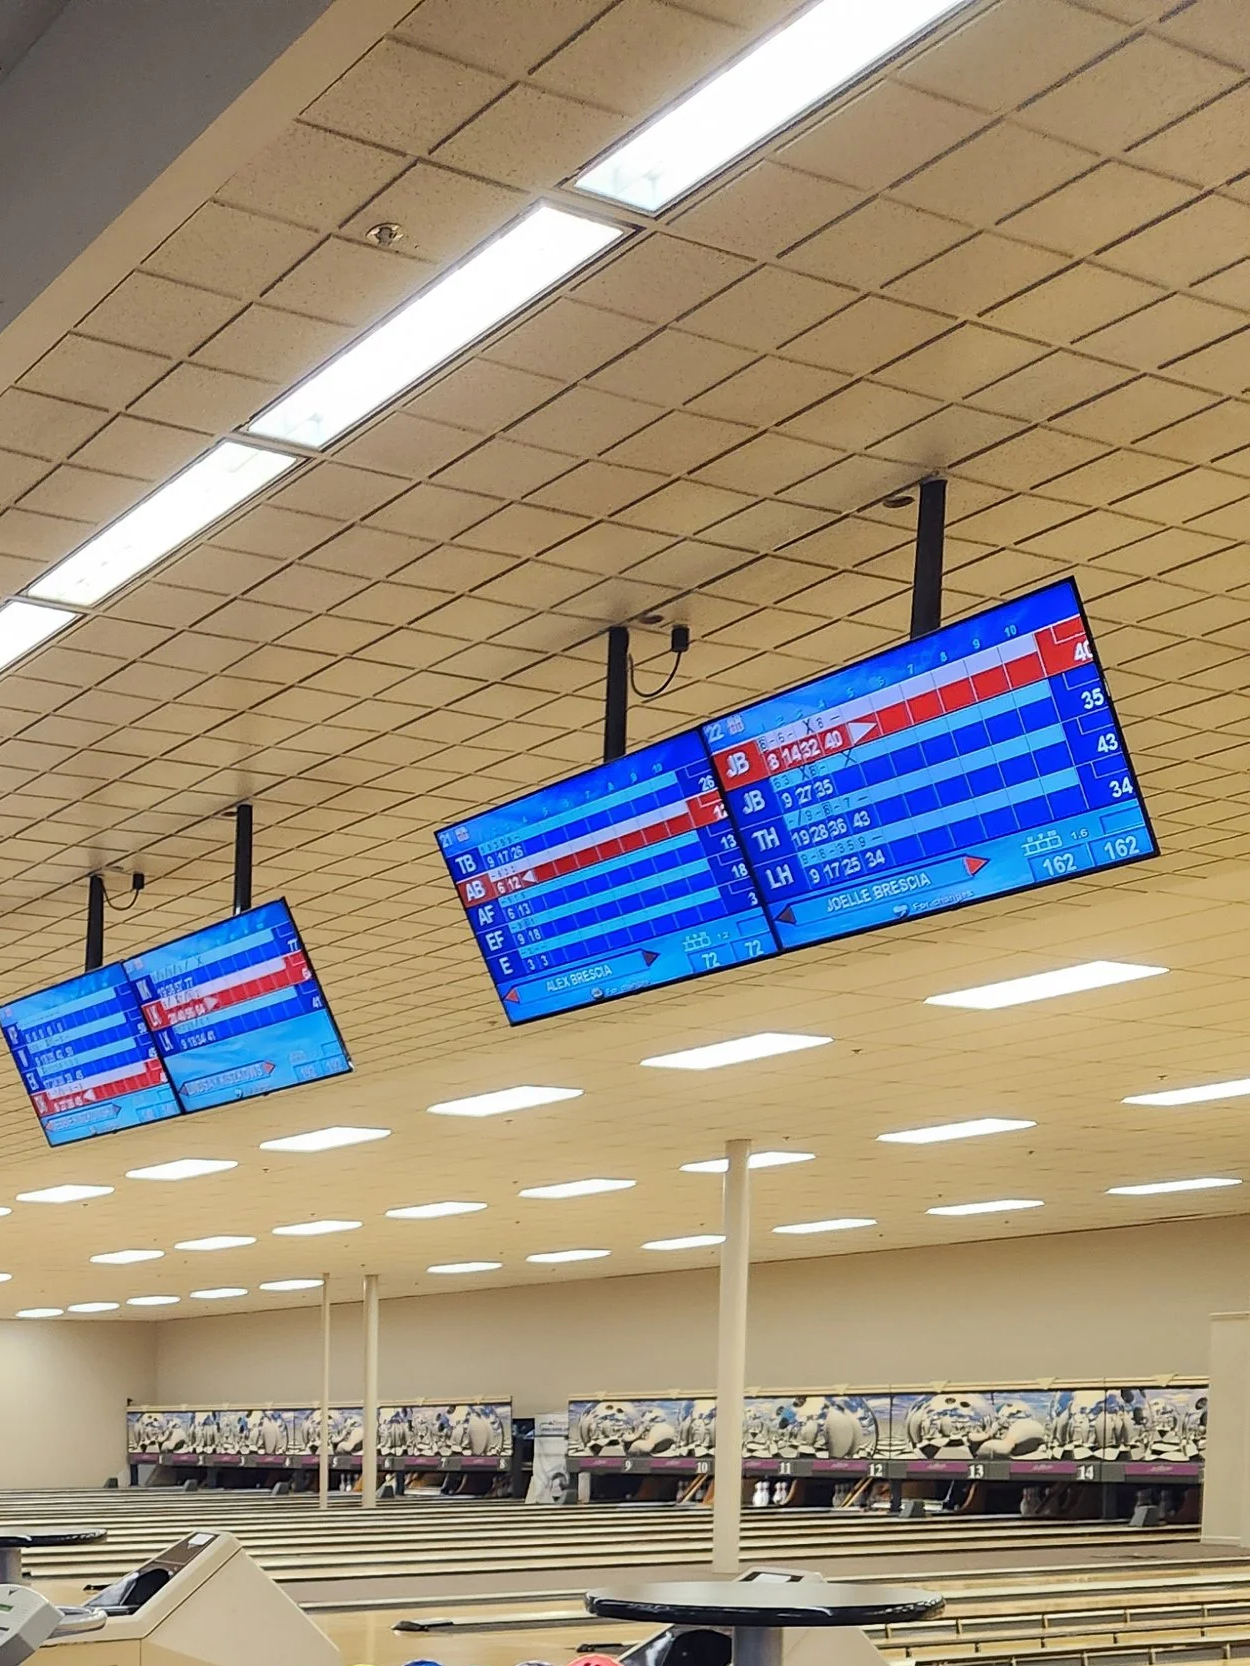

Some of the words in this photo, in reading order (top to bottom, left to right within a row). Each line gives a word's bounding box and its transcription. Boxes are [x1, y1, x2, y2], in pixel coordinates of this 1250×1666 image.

[940, 652, 948, 663] 8
[972, 639, 981, 650] 9
[1004, 625, 1018, 637] 10
[726, 751, 750, 778] JB
[767, 753, 780, 771] 8
[781, 744, 802, 764] 14
[824, 730, 843, 749] 40
[743, 789, 766, 815] JB
[781, 792, 793, 809] 9
[795, 784, 813, 805] 27
[813, 779, 834, 798] 35
[1081, 687, 1105, 709] 35
[751, 826, 781, 852] TH
[791, 829, 810, 847] 19
[809, 823, 829, 843] 28
[828, 818, 847, 837] 36
[853, 810, 871, 827] 43
[1097, 733, 1119, 753] 43
[455, 854, 477, 874] TB
[486, 856, 496, 868] 9
[510, 845, 524, 860] 26
[698, 774, 715, 791] 26
[765, 864, 794, 890] LH
[809, 869, 820, 885] 9
[823, 862, 841, 879] 17
[842, 858, 862, 876] 25
[865, 849, 886, 868] 34
[1109, 776, 1134, 798] 34
[1104, 835, 1140, 860] 162
[1042, 853, 1077, 878] 162
[465, 880, 486, 901] AB
[507, 876, 521, 890] 12
[477, 905, 495, 926] AF
[507, 908, 516, 919] 6
[518, 902, 531, 916] 13
[720, 834, 737, 850] 13
[826, 887, 872, 913] JOELLE
[872, 872, 932, 900] BRESCIA
[485, 930, 504, 951] EF
[517, 932, 526, 944] 9
[528, 928, 542, 942] 18
[731, 863, 748, 879] 18
[499, 957, 513, 975] E
[527, 959, 536, 971] 3
[540, 955, 549, 966] 3
[749, 892, 759, 906] 3
[702, 952, 721, 969] 72
[744, 939, 764, 957] 72
[546, 976, 570, 992] ALEX
[571, 964, 613, 987] BRESCIA
[624, 1460, 632, 1472] 9
[695, 1461, 709, 1473] 10
[779, 1462, 791, 1475] 11
[869, 1463, 883, 1477] 12
[968, 1464, 984, 1479] 13
[1077, 1465, 1094, 1480] 14
